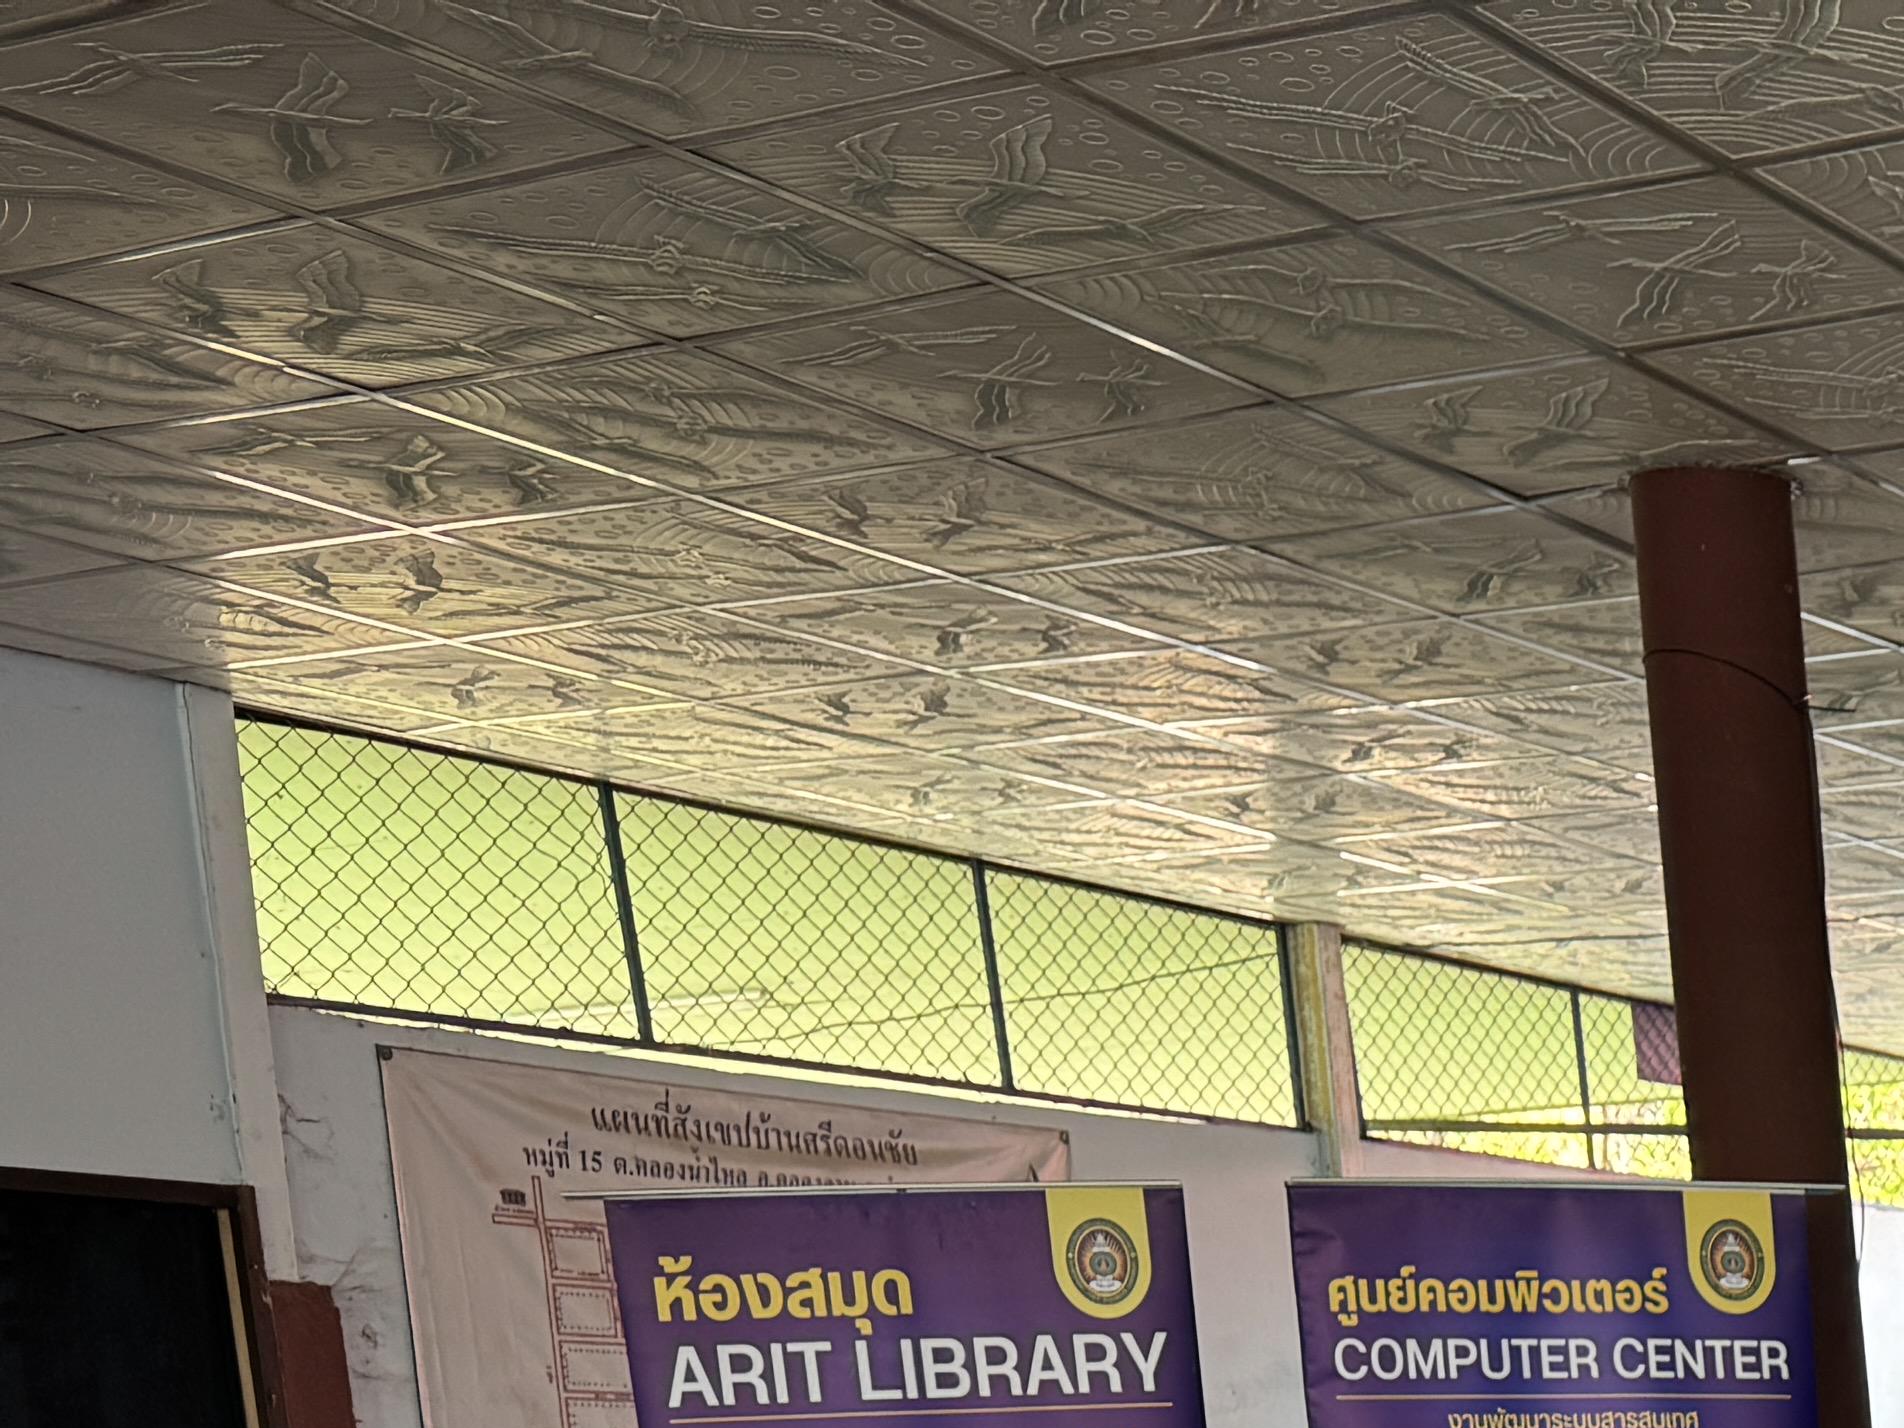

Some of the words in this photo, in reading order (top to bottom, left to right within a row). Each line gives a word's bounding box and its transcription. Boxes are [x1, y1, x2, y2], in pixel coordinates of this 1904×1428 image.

[522, 1132, 571, 1178] หมู่ที่
[579, 1149, 602, 1173] 15
[591, 1088, 917, 1166] แผนที่สังเขปบ้านศรีดอนชัย
[654, 1254, 914, 1334] ห้องสมุด
[1328, 1265, 1669, 1327] ศูนย์คอมพิวเตอร์
[668, 1341, 832, 1409] ARIT
[854, 1330, 1168, 1403] LIBRARY
[1334, 1338, 1599, 1381] COMPUTER
[1613, 1338, 1790, 1381] CENTER
